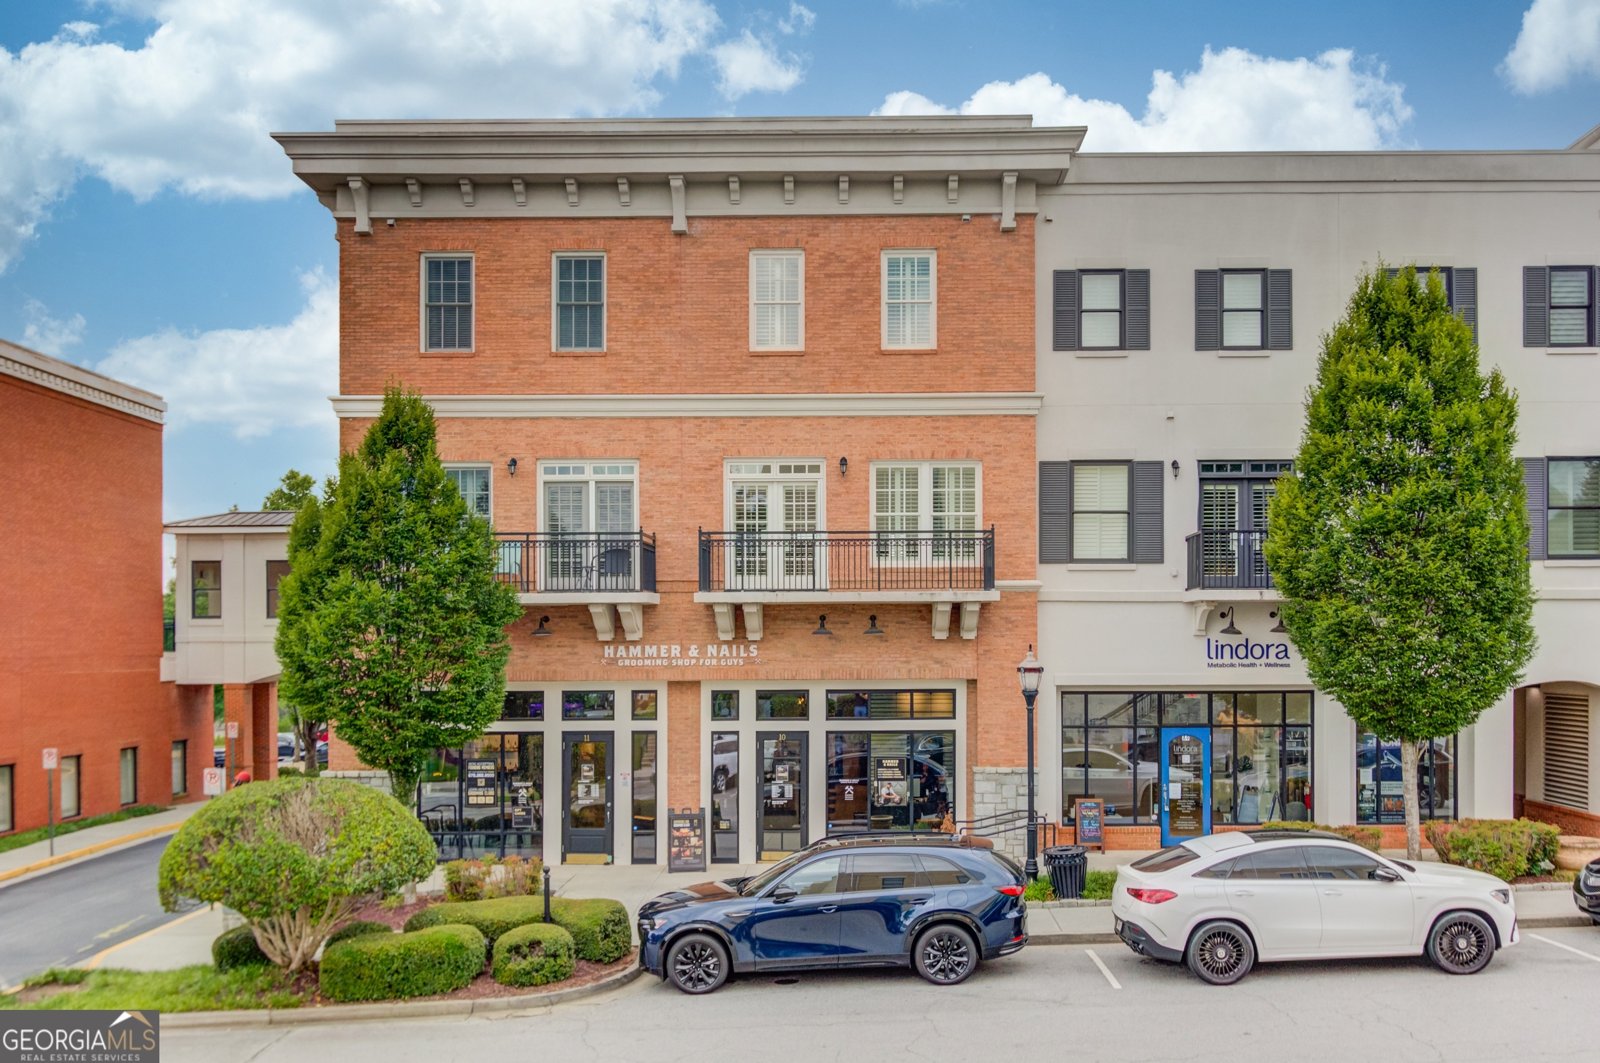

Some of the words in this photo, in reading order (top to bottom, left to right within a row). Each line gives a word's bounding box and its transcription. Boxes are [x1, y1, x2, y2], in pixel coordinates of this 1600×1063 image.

[604, 645, 682, 658] HAMMER
[688, 645, 700, 658] &
[707, 644, 758, 657] NAILS
[1206, 638, 1290, 660] lindora
[618, 658, 669, 667] GROOMING
[671, 658, 697, 667] SHOP
[700, 658, 718, 666] FOR
[720, 658, 744, 666] GUYS
[584, 734, 590, 742] 11
[779, 733, 787, 741] 10
